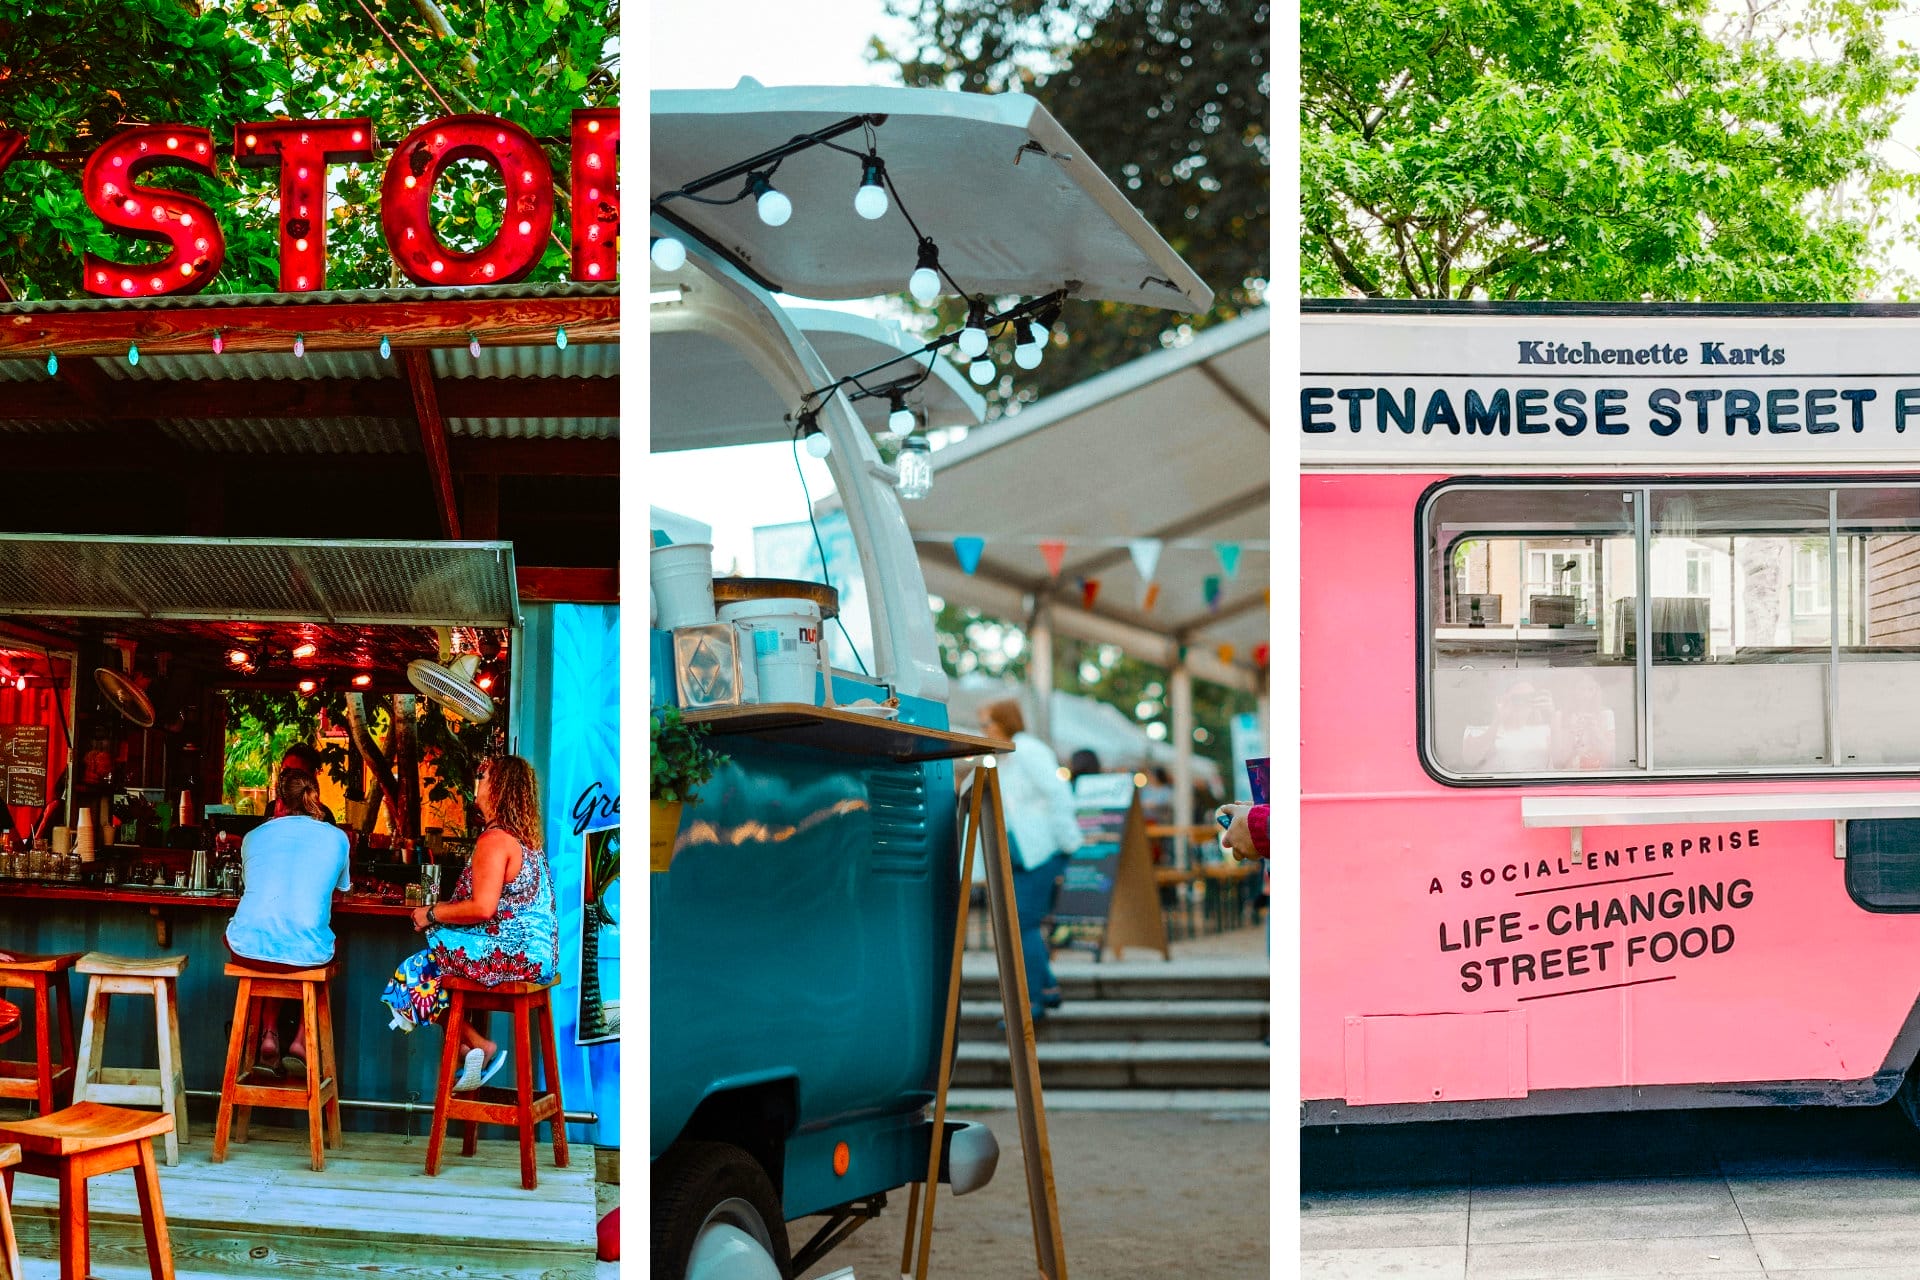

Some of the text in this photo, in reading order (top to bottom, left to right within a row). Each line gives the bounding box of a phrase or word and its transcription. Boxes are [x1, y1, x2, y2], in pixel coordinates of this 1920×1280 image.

[1518, 340, 1786, 366] Kitchenette Karts
[1301, 387, 1630, 437] ETNAMESE
[1648, 387, 1878, 437] STREET
[799, 627, 817, 643] nu
[1429, 829, 1760, 895] A SOCIAL ENTERPRISE
[1440, 878, 1754, 952] LIFE-CHANGING
[1460, 923, 1735, 993] STREET FOOD
